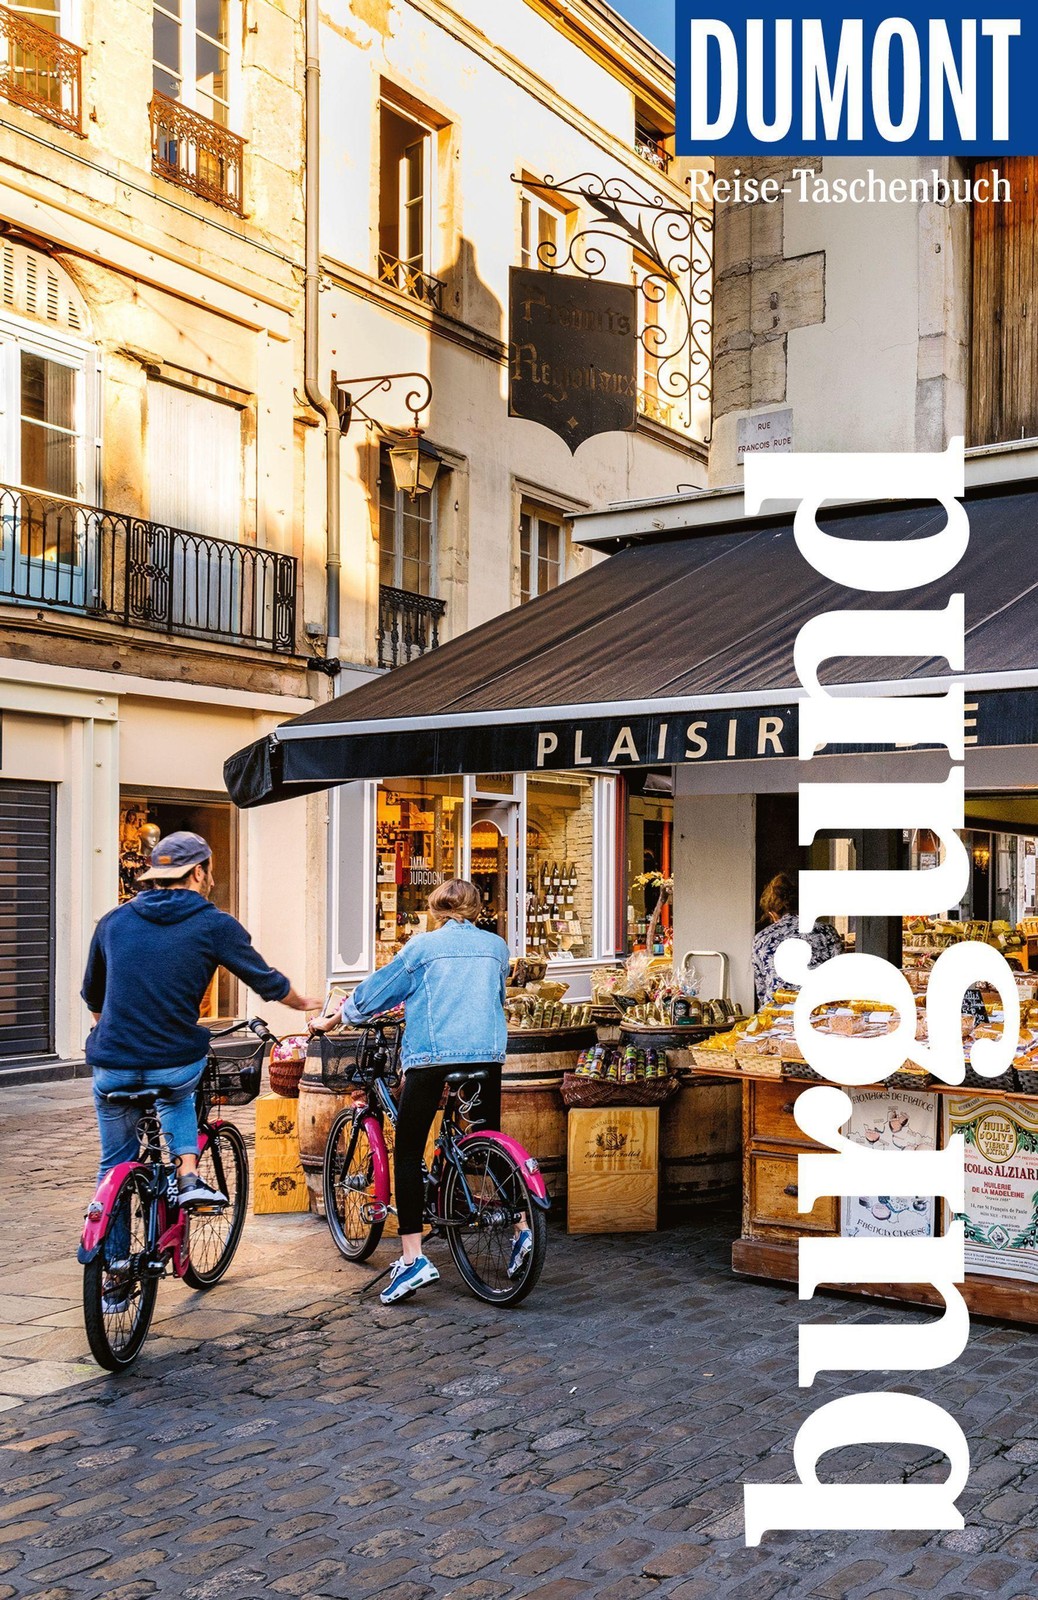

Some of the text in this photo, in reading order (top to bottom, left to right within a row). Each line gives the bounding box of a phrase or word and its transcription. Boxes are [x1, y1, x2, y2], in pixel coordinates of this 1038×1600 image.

[758, 422, 770, 430] RUE
[774, 437, 791, 446] RUDE
[535, 716, 827, 767] PLAISIR
[903, 1095, 933, 1112] FRANCE
[984, 1122, 1010, 1132] HUILE
[985, 1141, 1009, 1150] VIERGE
[986, 1148, 1007, 1156] EXTRA
[984, 1182, 1011, 1190] HUILERIE
[990, 1190, 1024, 1198] MADELEINE
